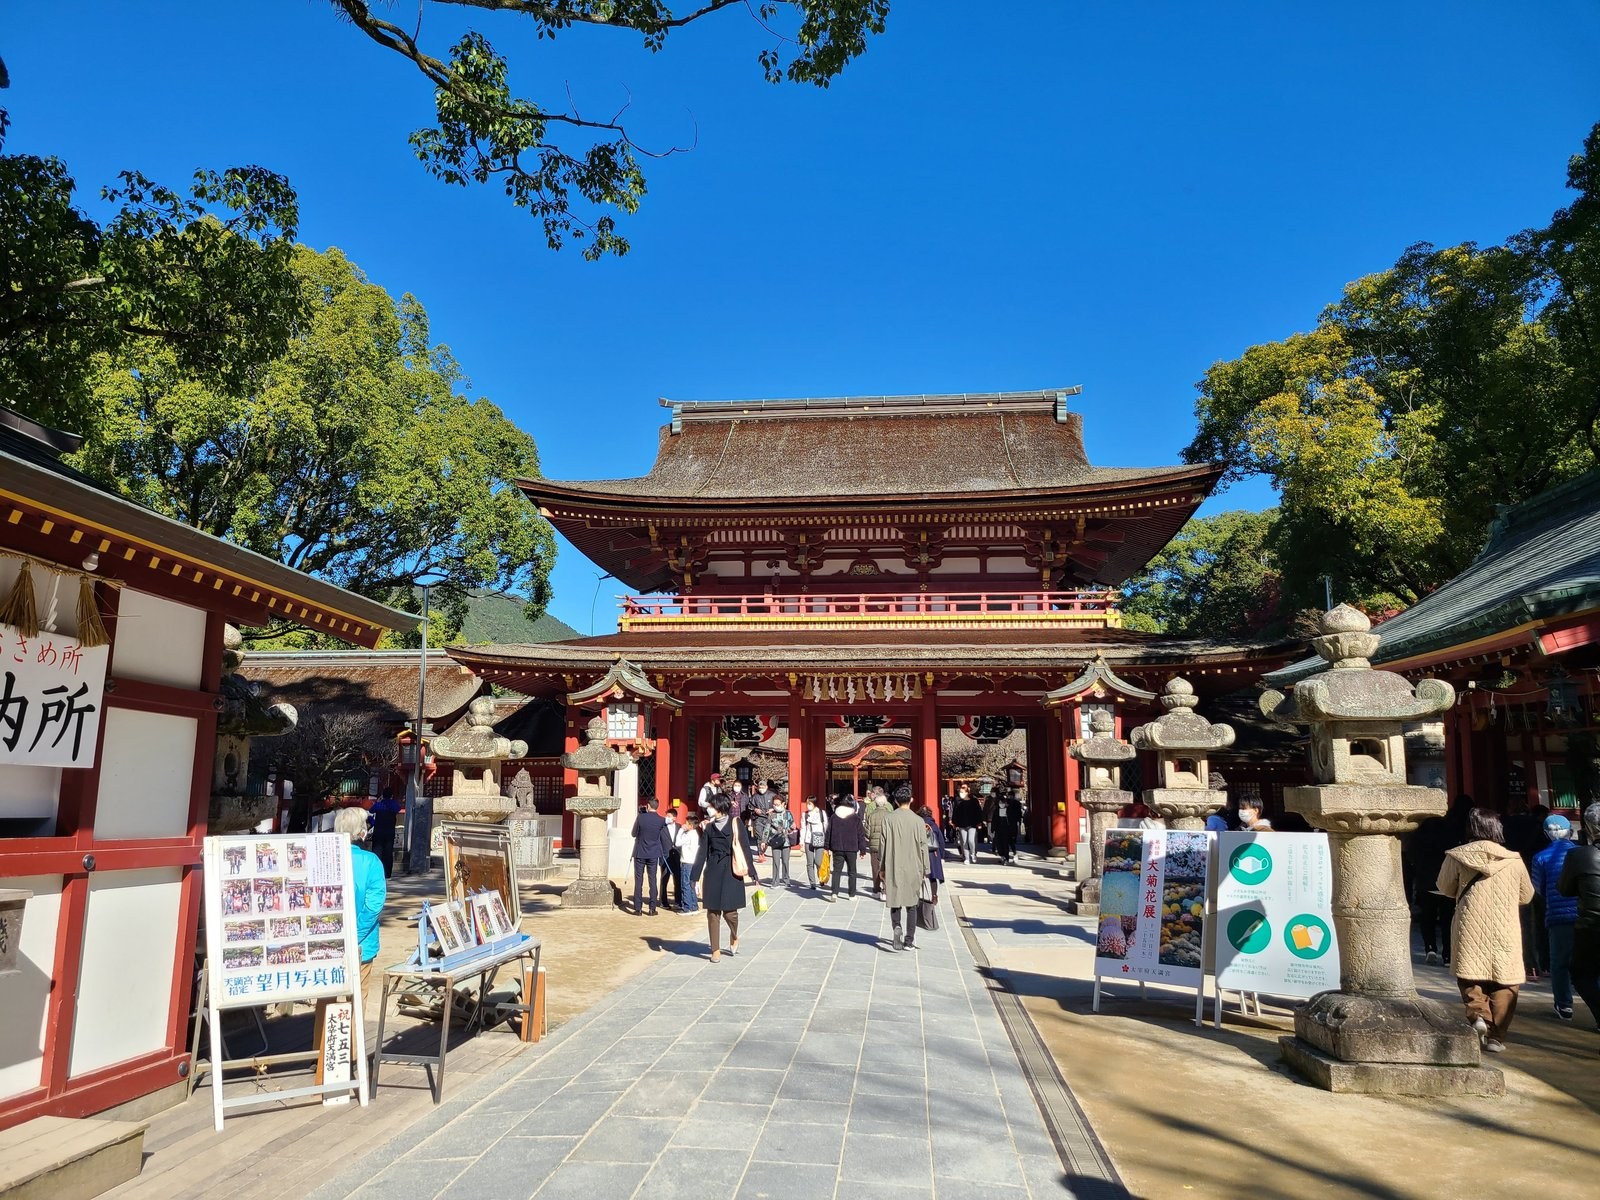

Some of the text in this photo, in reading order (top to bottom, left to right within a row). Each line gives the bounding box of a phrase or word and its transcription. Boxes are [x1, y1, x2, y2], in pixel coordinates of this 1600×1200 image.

[0, 633, 83, 675] さめ所
[1143, 859, 1159, 919] 大菊花展
[228, 985, 250, 996] 指定
[256, 965, 346, 992] 望月写真館
